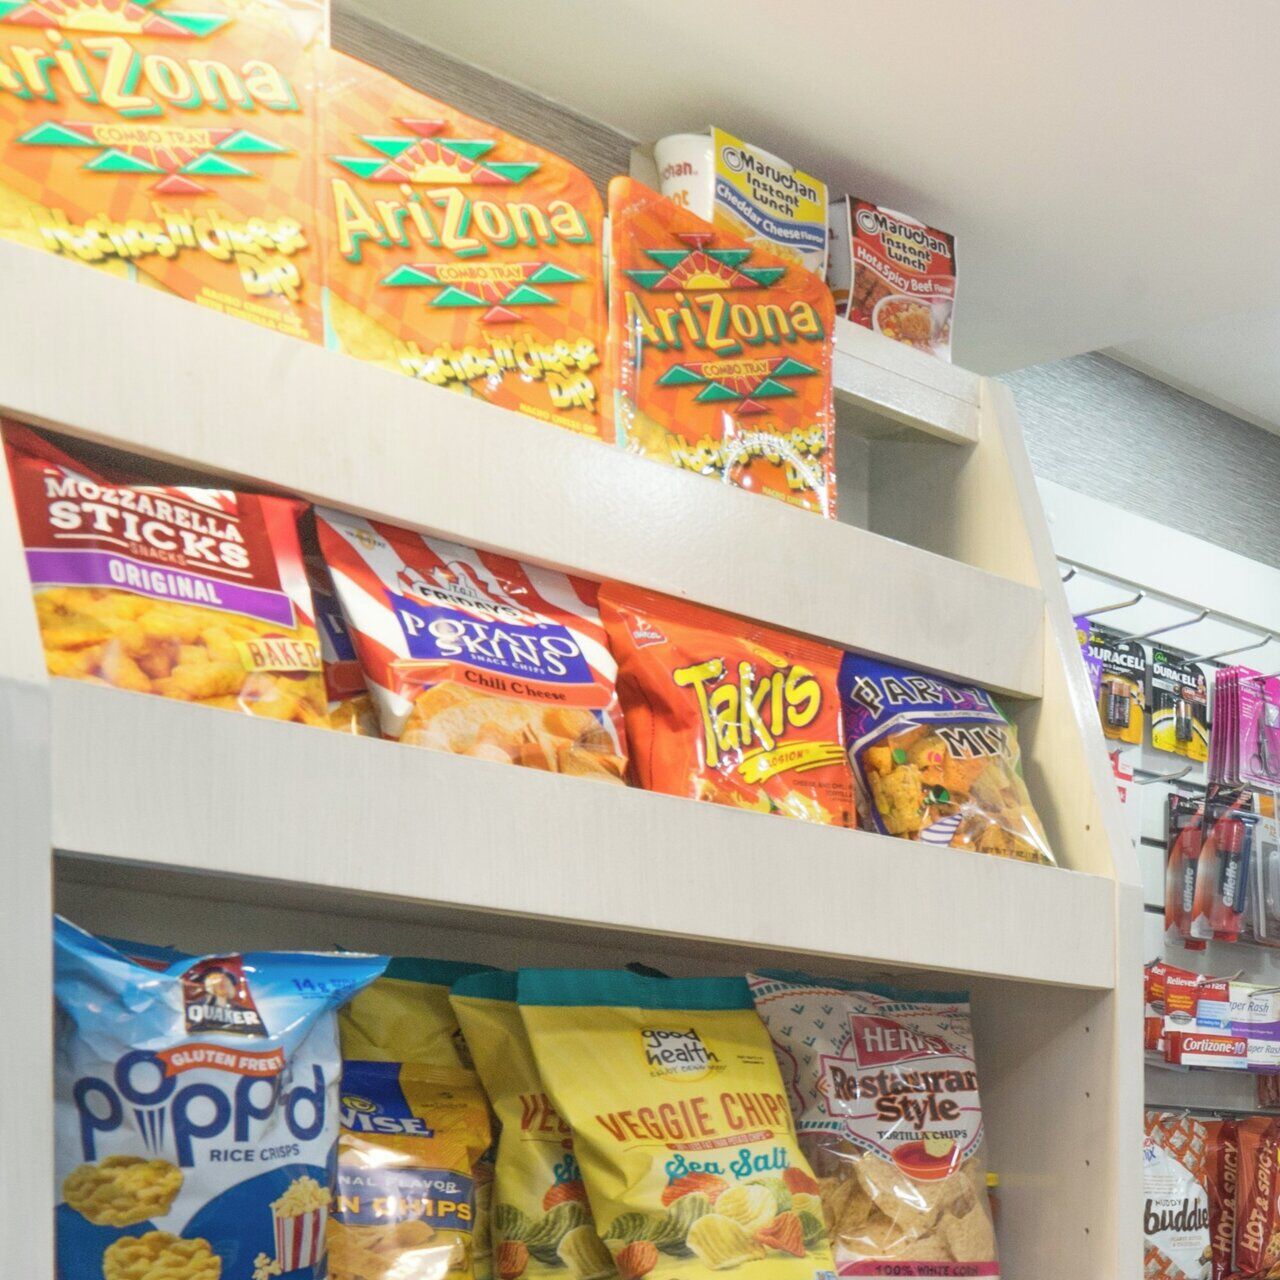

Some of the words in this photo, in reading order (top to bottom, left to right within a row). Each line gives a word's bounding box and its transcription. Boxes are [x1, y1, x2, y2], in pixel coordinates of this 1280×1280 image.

[738, 151, 817, 202] Maruchan
[746, 172, 800, 209] Instant
[752, 189, 795, 218] Lunch
[873, 213, 950, 253] Maruchan
[880, 232, 931, 262] Instant
[886, 248, 927, 272] Lunch
[44, 476, 244, 543] MOZZARELLA
[49, 501, 250, 568] STICKS
[129, 541, 188, 566] SNACKS
[109, 559, 223, 604] ORIGINAL
[419, 586, 518, 618] FRIDAYS
[400, 609, 579, 659] POTATO
[249, 640, 320, 669] BAKED
[436, 637, 567, 676] SKINS
[464, 669, 506, 691] Chili
[511, 681, 567, 701] Cheese
[1154, 663, 1197, 687] DURACELL
[673, 657, 822, 768] Takis
[1183, 866, 1195, 913] Gillette
[1221, 859, 1238, 907] Gillette
[188, 1003, 259, 1026] QUAKER
[1249, 1001, 1270, 1014] Rash
[641, 1026, 702, 1052] good
[645, 1043, 720, 1066] health
[830, 1067, 978, 1101] Restauran
[596, 1097, 709, 1144] VEGGIE
[876, 1094, 961, 1133] Style
[877, 1130, 930, 1141] TORTILLA
[932, 1129, 968, 1141] CHIPS
[209, 1148, 255, 1163] RICE
[259, 1143, 299, 1162] CRISPS
[666, 1152, 726, 1186] Sea
[730, 1147, 791, 1178] Salt
